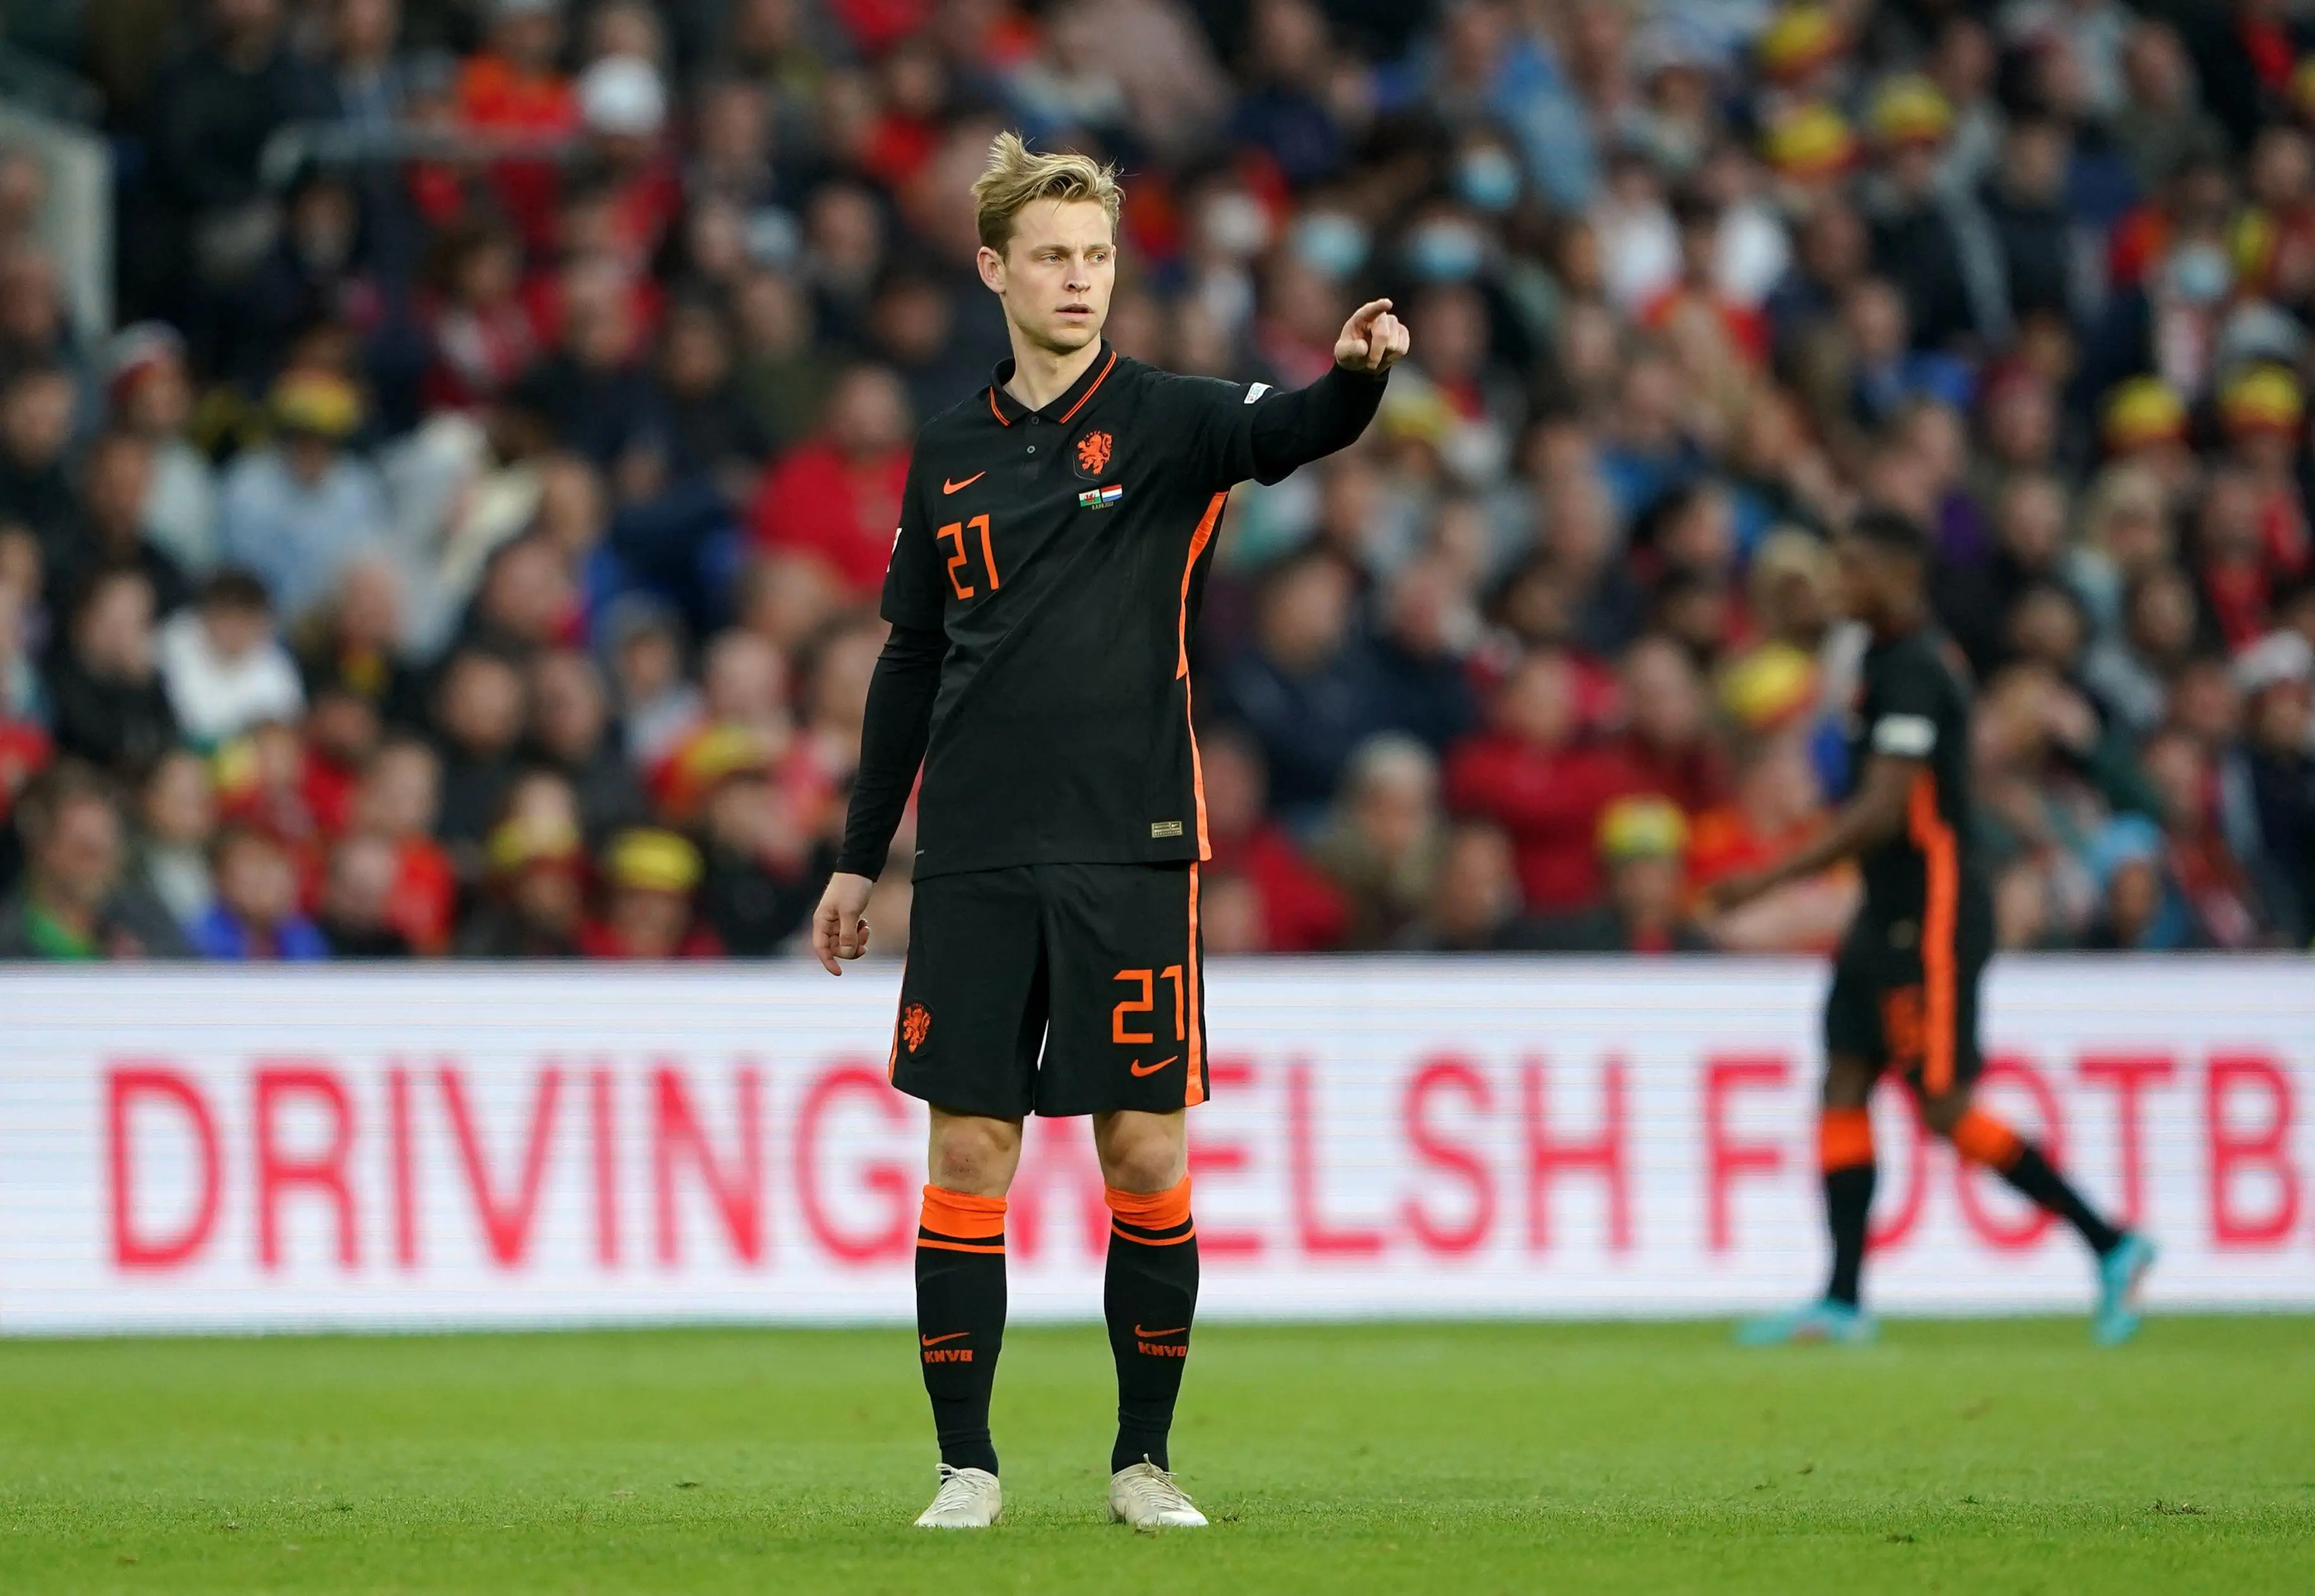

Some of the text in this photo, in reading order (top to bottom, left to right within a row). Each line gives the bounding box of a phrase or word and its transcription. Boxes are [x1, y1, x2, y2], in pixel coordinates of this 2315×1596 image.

[936, 513, 999, 600] 21
[1112, 964, 1186, 1044] 21
[105, 1060, 915, 1272] DRIVING
[924, 1349, 973, 1363] KNVB
[1138, 1340, 1187, 1357] KNVB
